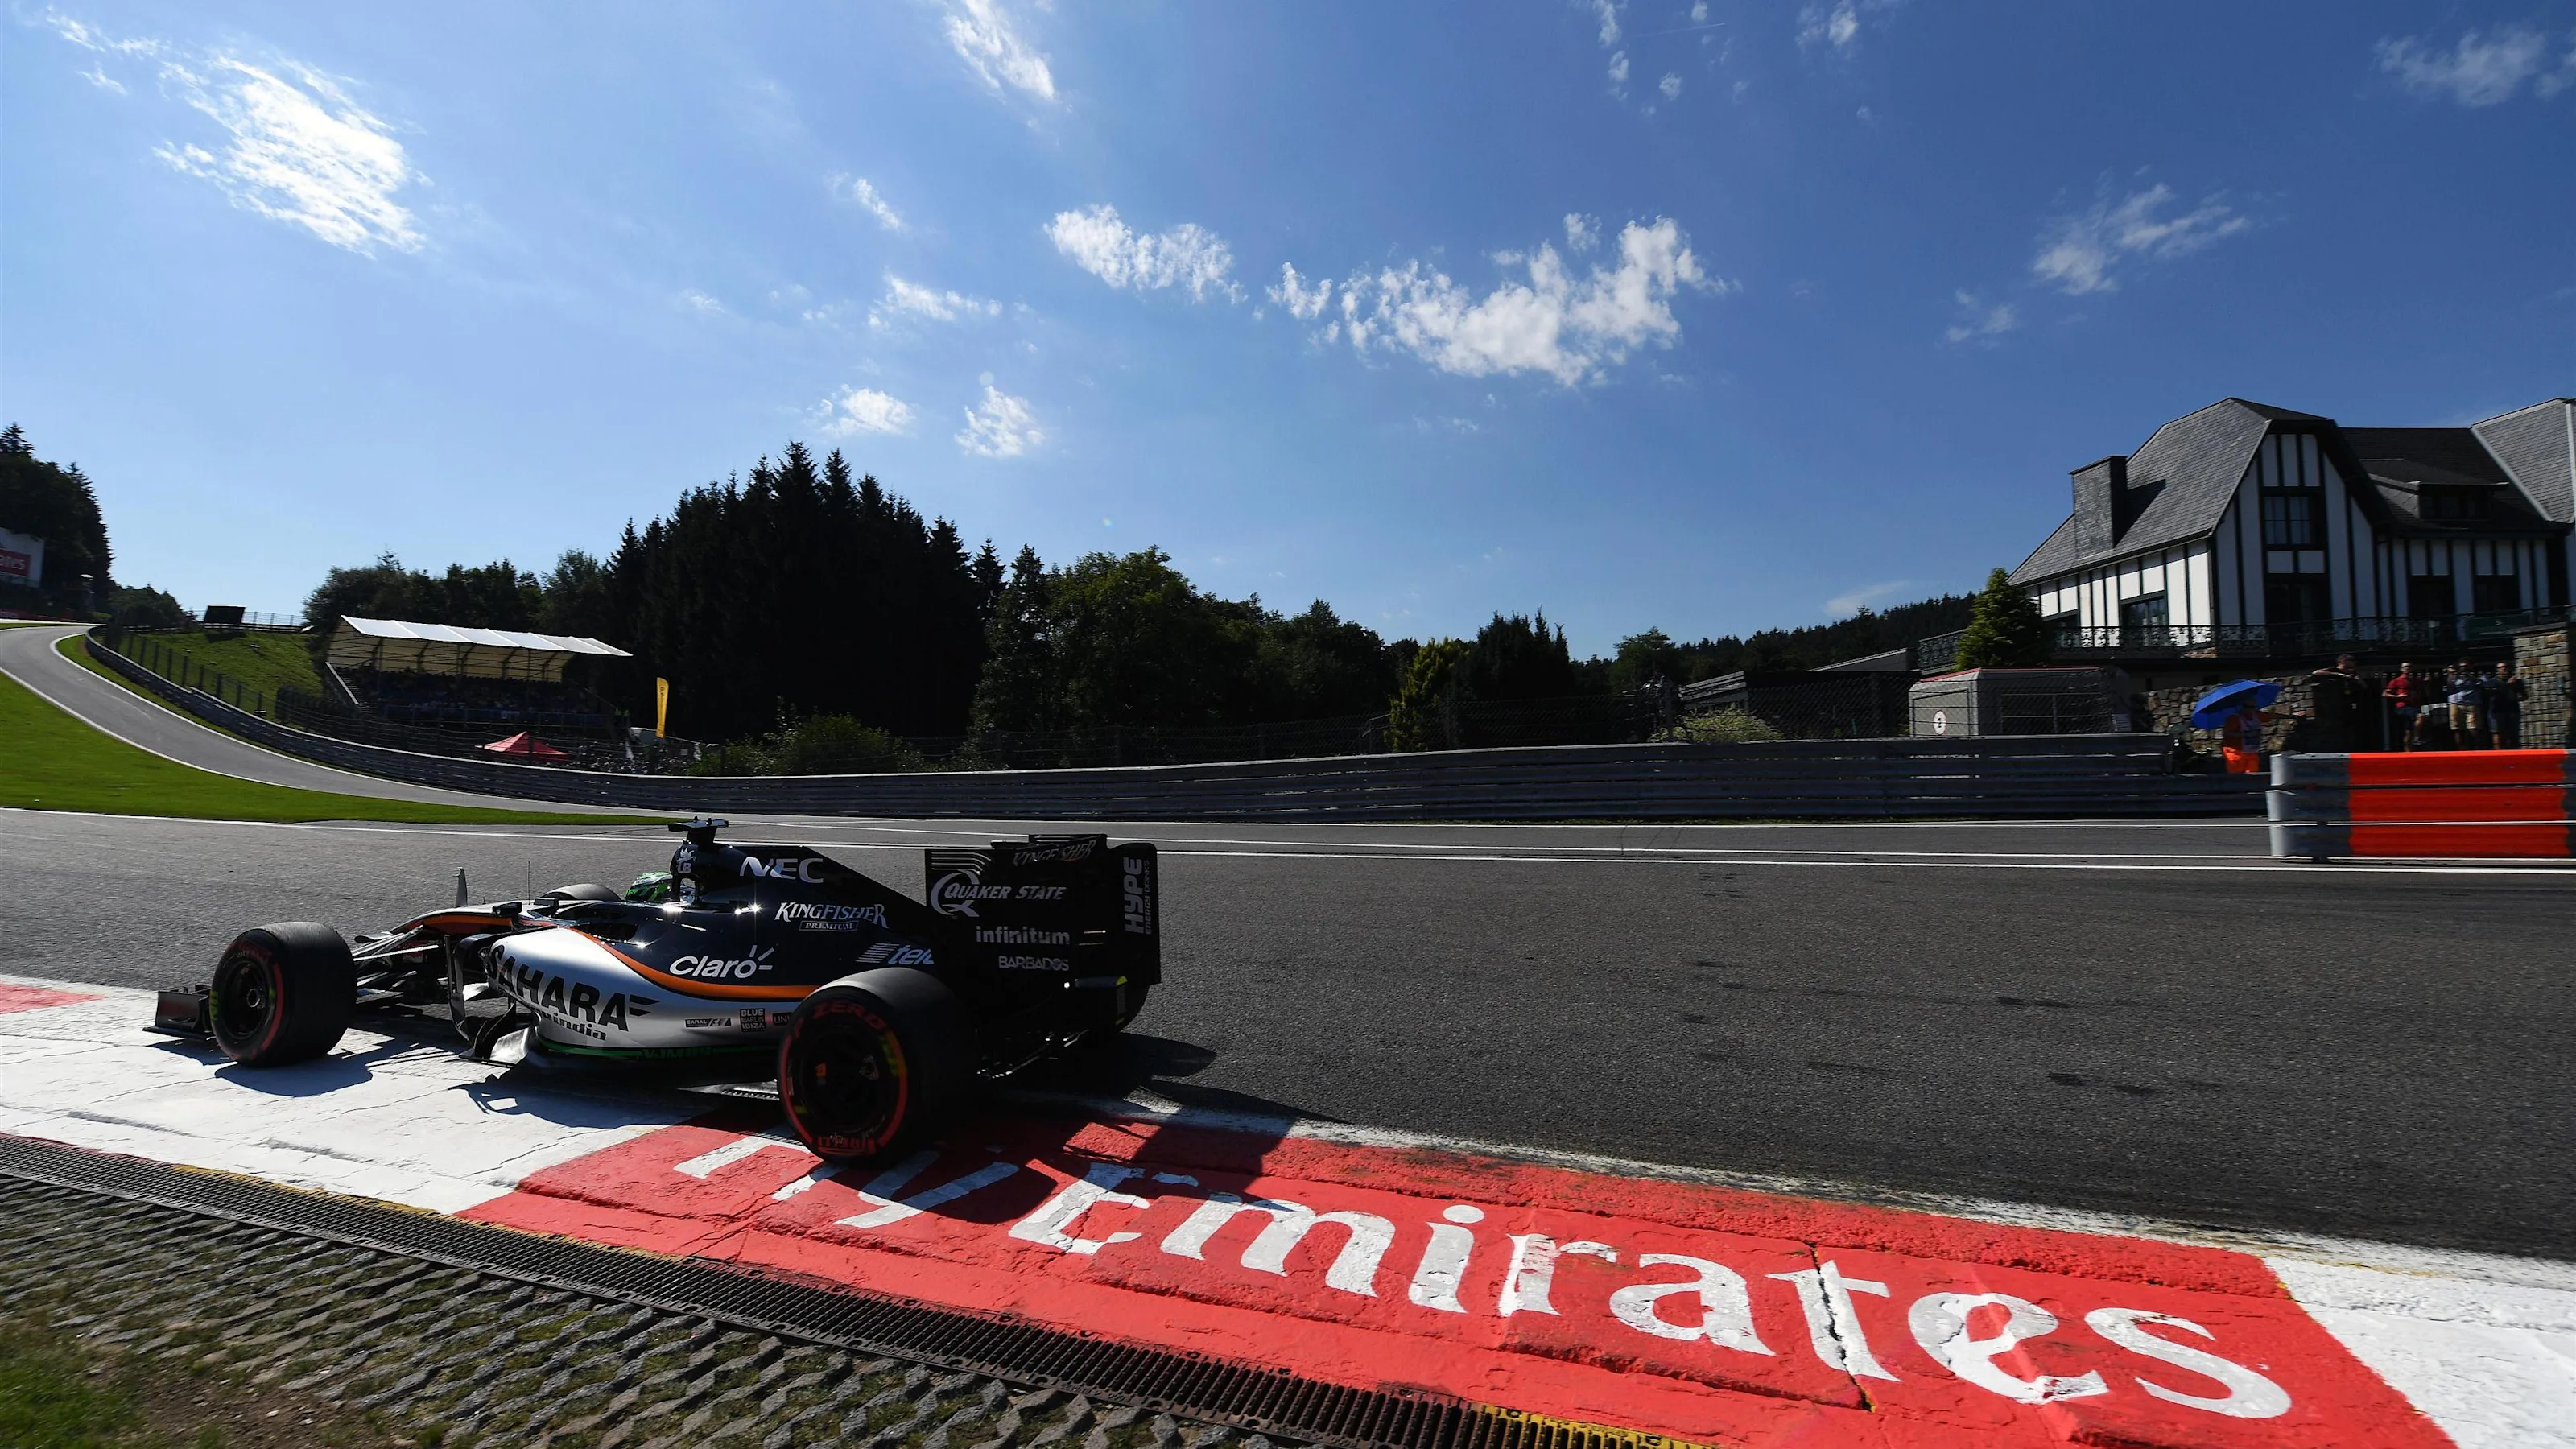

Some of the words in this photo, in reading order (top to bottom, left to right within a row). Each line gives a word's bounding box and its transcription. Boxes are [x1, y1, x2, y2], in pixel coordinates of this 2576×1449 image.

[739, 856, 824, 884] NEC
[943, 883, 1011, 899] QUAKER
[1014, 885, 1067, 900] STATE
[1123, 857, 1143, 935] HYPE
[774, 902, 890, 929] KINGFISHER
[804, 922, 854, 931] PREMIUM
[975, 926, 1070, 945] infinitum
[669, 952, 758, 979] Claro
[998, 955, 1070, 971] BARBADOS
[488, 944, 630, 1032] SAHARA
[741, 1022, 765, 1030] IBIZA
[1007, 1161, 2292, 1419] Emirates
